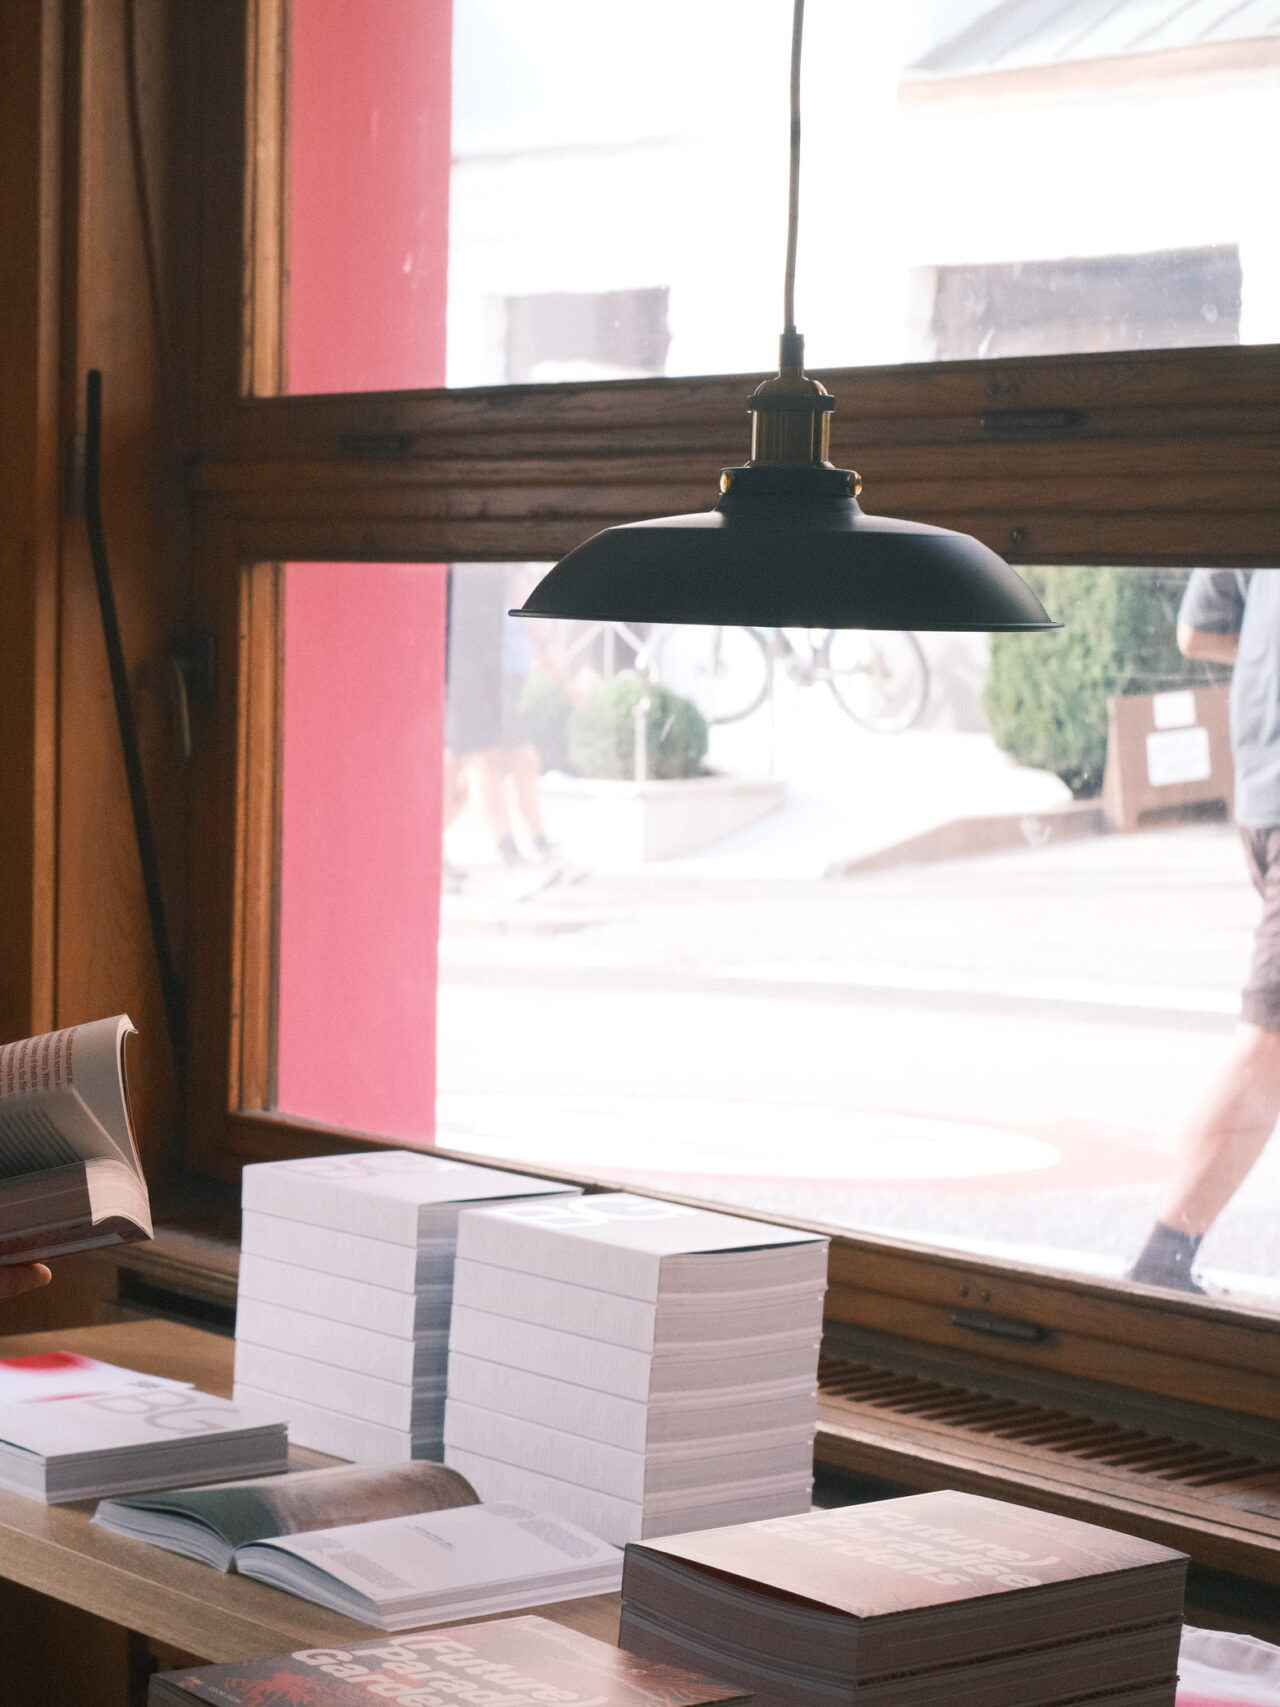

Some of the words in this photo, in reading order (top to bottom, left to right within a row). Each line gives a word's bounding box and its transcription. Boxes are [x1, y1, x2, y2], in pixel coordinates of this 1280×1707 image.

[496, 1194, 695, 1229] BG
[83, 1388, 240, 1434] BG
[800, 1513, 1042, 1587] Paradise
[831, 1507, 1060, 1567] (Future)
[388, 1634, 608, 1707] (Future)
